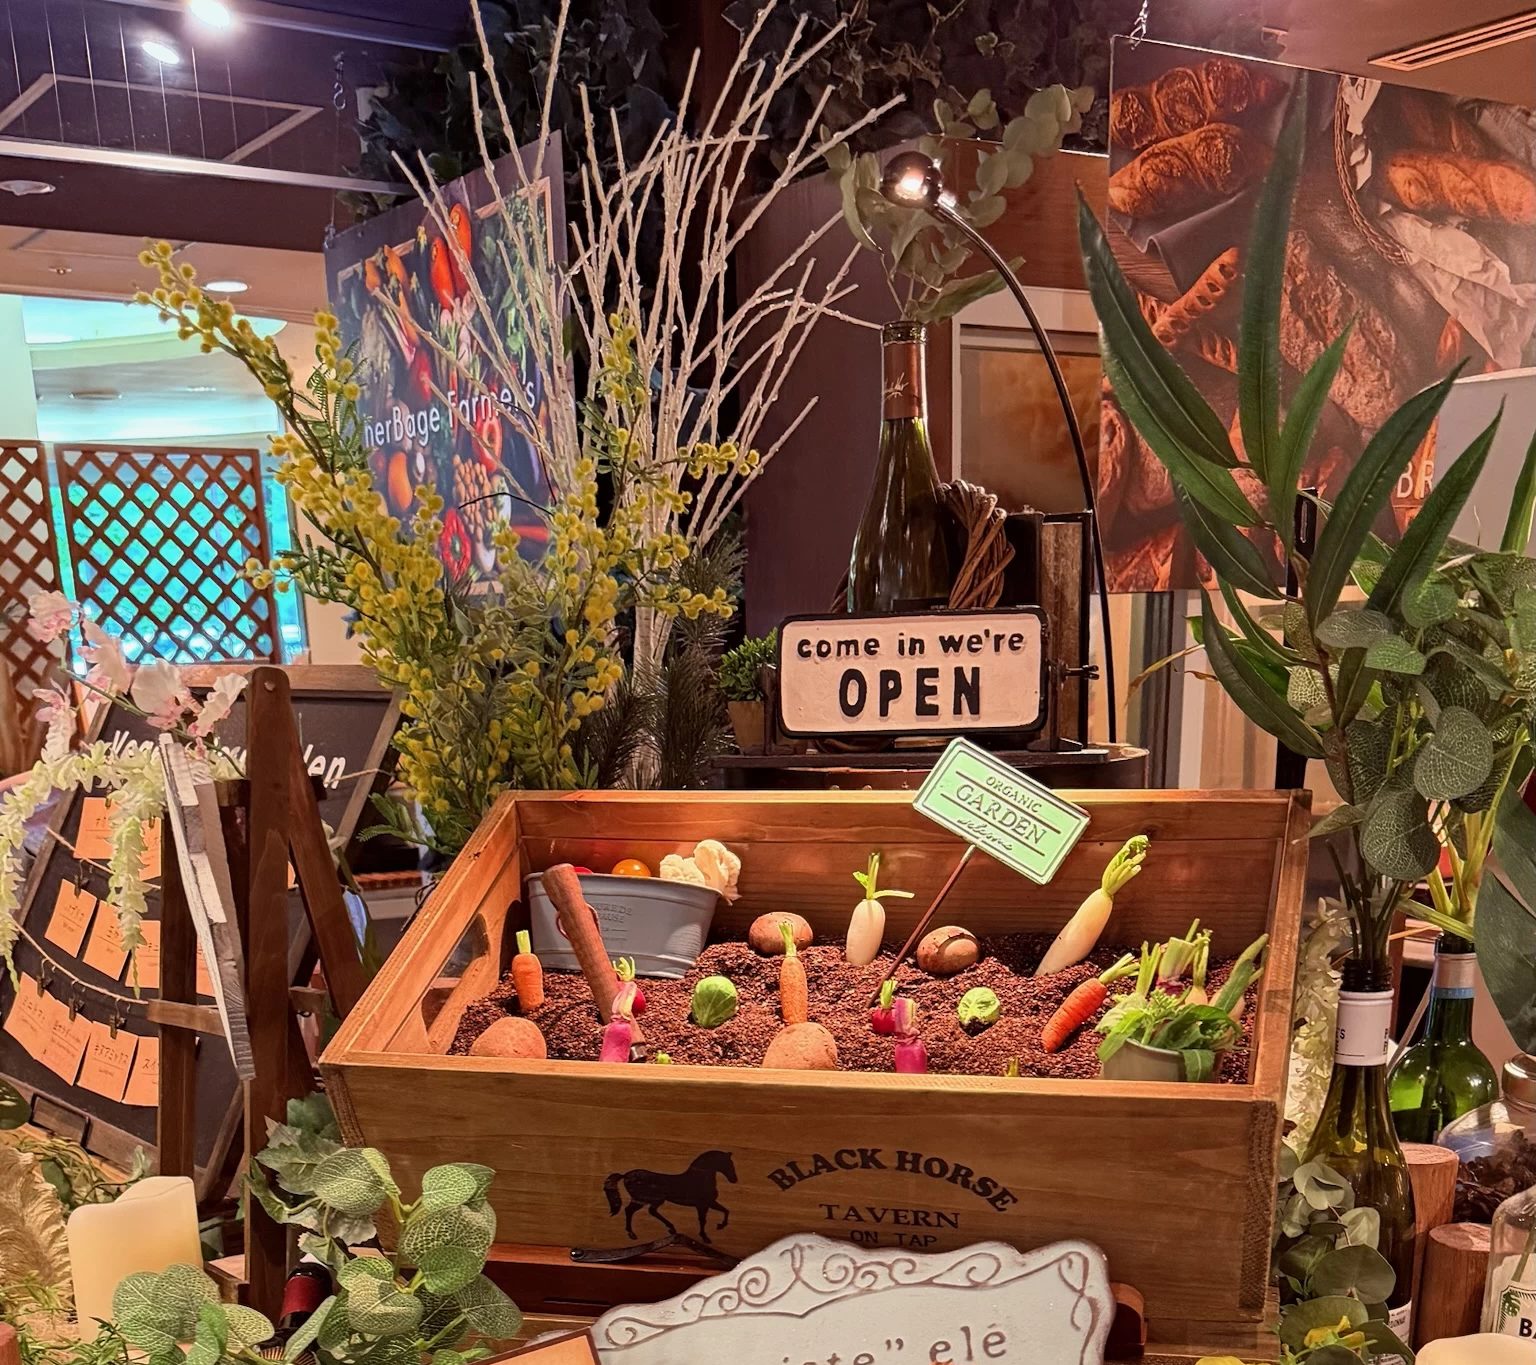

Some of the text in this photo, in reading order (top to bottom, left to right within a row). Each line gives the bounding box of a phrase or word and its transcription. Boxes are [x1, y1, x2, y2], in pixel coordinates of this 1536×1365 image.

[796, 628, 1024, 658] come in we're
[838, 666, 981, 718] OPEN
[985, 776, 1042, 813] ORGANIC
[956, 784, 1047, 845] GARDEN
[767, 1148, 1018, 1213] BLACK HORSE
[818, 1203, 960, 1229] TAVERN
[850, 1229, 937, 1248] ON TAP
[1519, 1317, 1536, 1339] B
